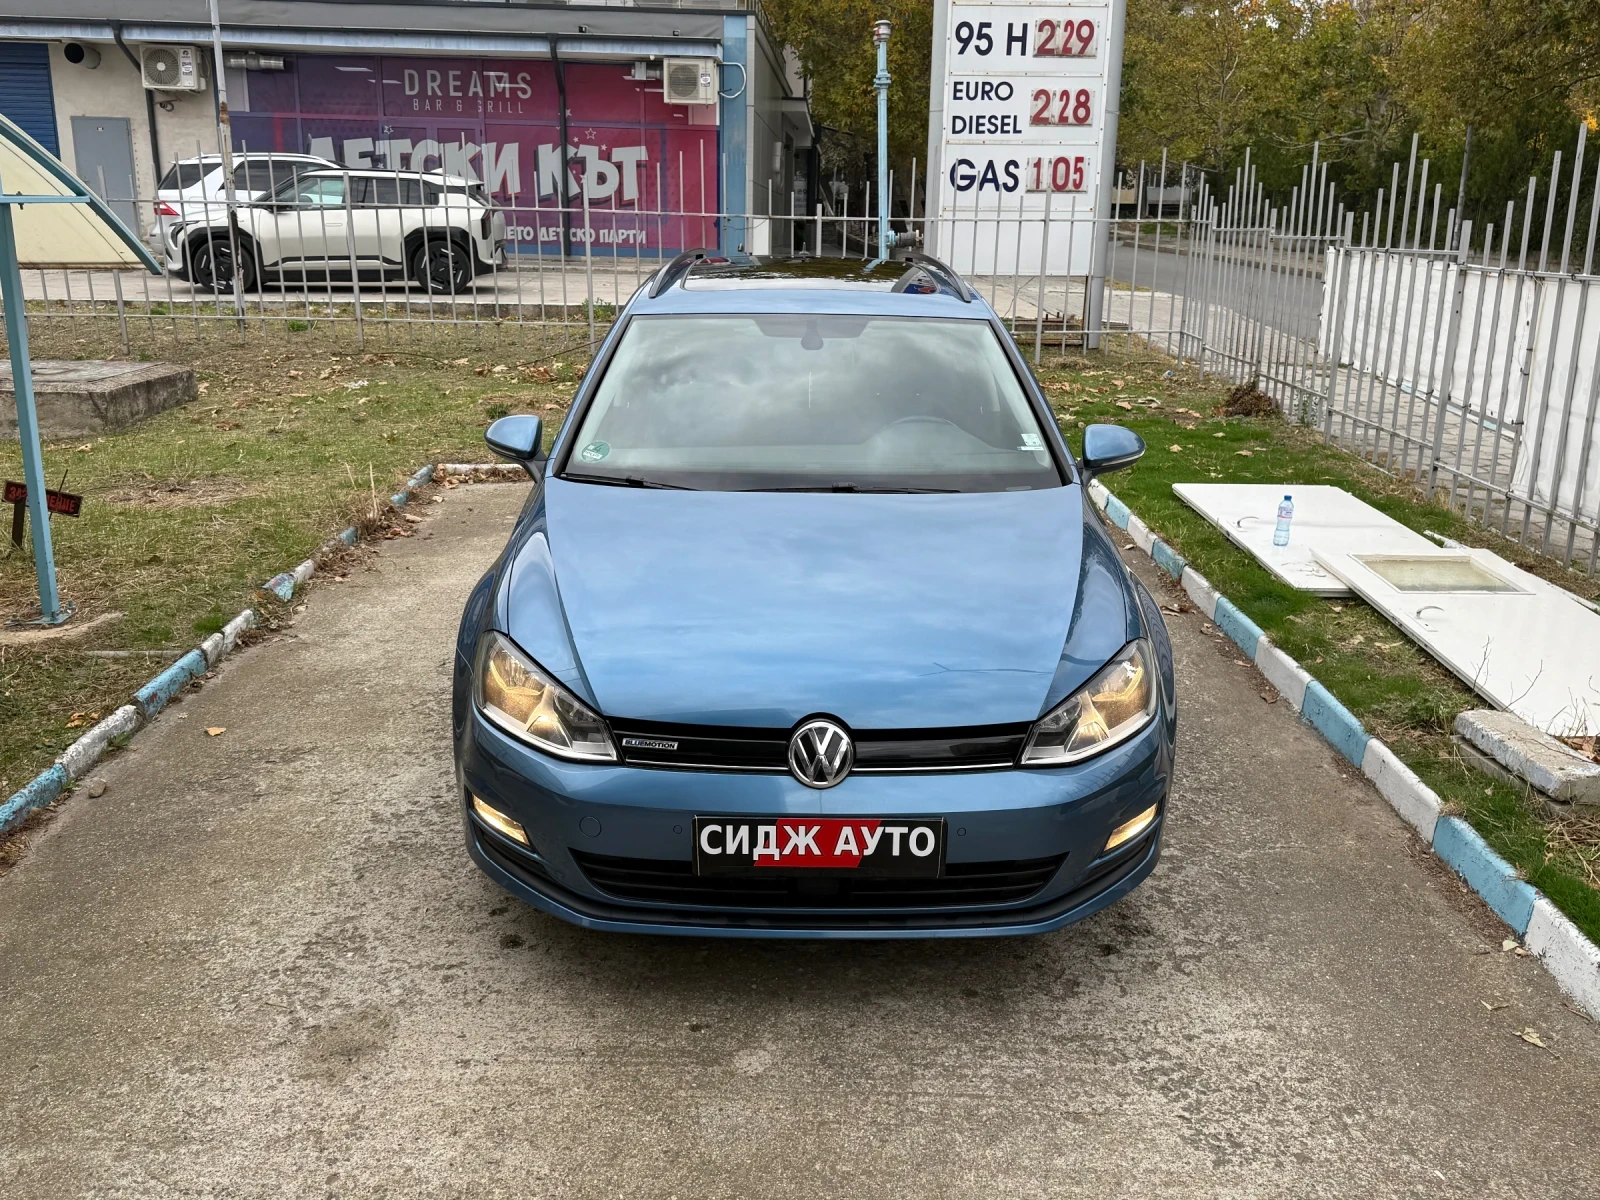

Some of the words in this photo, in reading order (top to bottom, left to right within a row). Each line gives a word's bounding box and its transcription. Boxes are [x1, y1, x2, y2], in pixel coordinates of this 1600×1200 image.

[955, 21, 993, 56] 95
[1006, 22, 1028, 56] H
[1037, 19, 1095, 55] 229
[404, 69, 532, 99] DREAMS
[953, 81, 1014, 101] EURO
[413, 99, 442, 111] BAR
[456, 100, 463, 112] &
[477, 100, 524, 114] GRILL
[1032, 88, 1091, 125] 228
[951, 114, 1022, 135] DIESEL
[537, 143, 649, 201] КЪТ
[950, 158, 1020, 193] GAS
[1032, 156, 1085, 192] 105
[599, 228, 646, 244] ПАРТИ
[624, 739, 676, 749] BLUEMOTION
[700, 824, 823, 861] СИДЖ
[834, 825, 936, 858] АУТО
